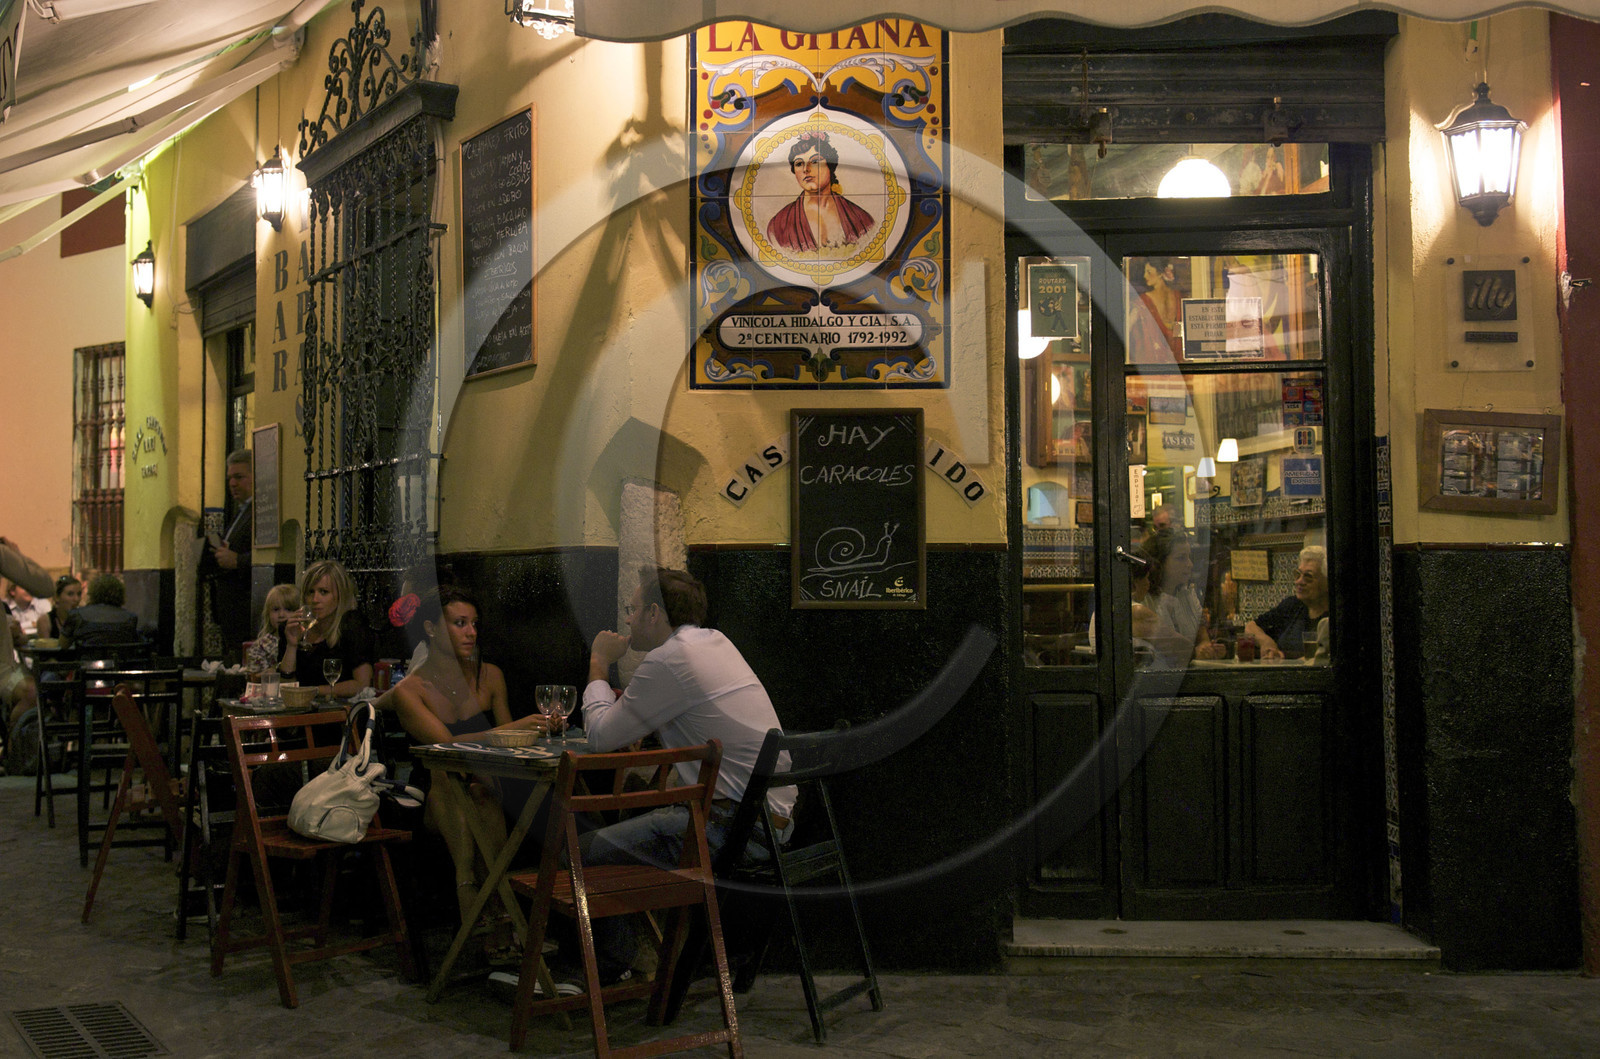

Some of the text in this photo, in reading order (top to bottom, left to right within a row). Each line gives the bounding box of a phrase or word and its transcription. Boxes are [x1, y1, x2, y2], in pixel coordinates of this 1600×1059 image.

[708, 21, 764, 52] LA
[1039, 285, 1067, 294] 2001
[1468, 277, 1515, 317] illy
[272, 250, 288, 393] BAR
[731, 317, 787, 327] VINICOLA
[791, 316, 843, 327] HIDALGO
[847, 316, 856, 327] Y
[890, 316, 915, 326] S.A.
[755, 332, 841, 345] CENTENARIO
[848, 331, 907, 344] 1792-1992
[818, 424, 895, 451] HAY
[1165, 436, 1195, 446] ASEOS
[726, 445, 985, 501] CAS IDO
[800, 464, 915, 486] CARACOLES
[1291, 477, 1321, 485] EXPRESS
